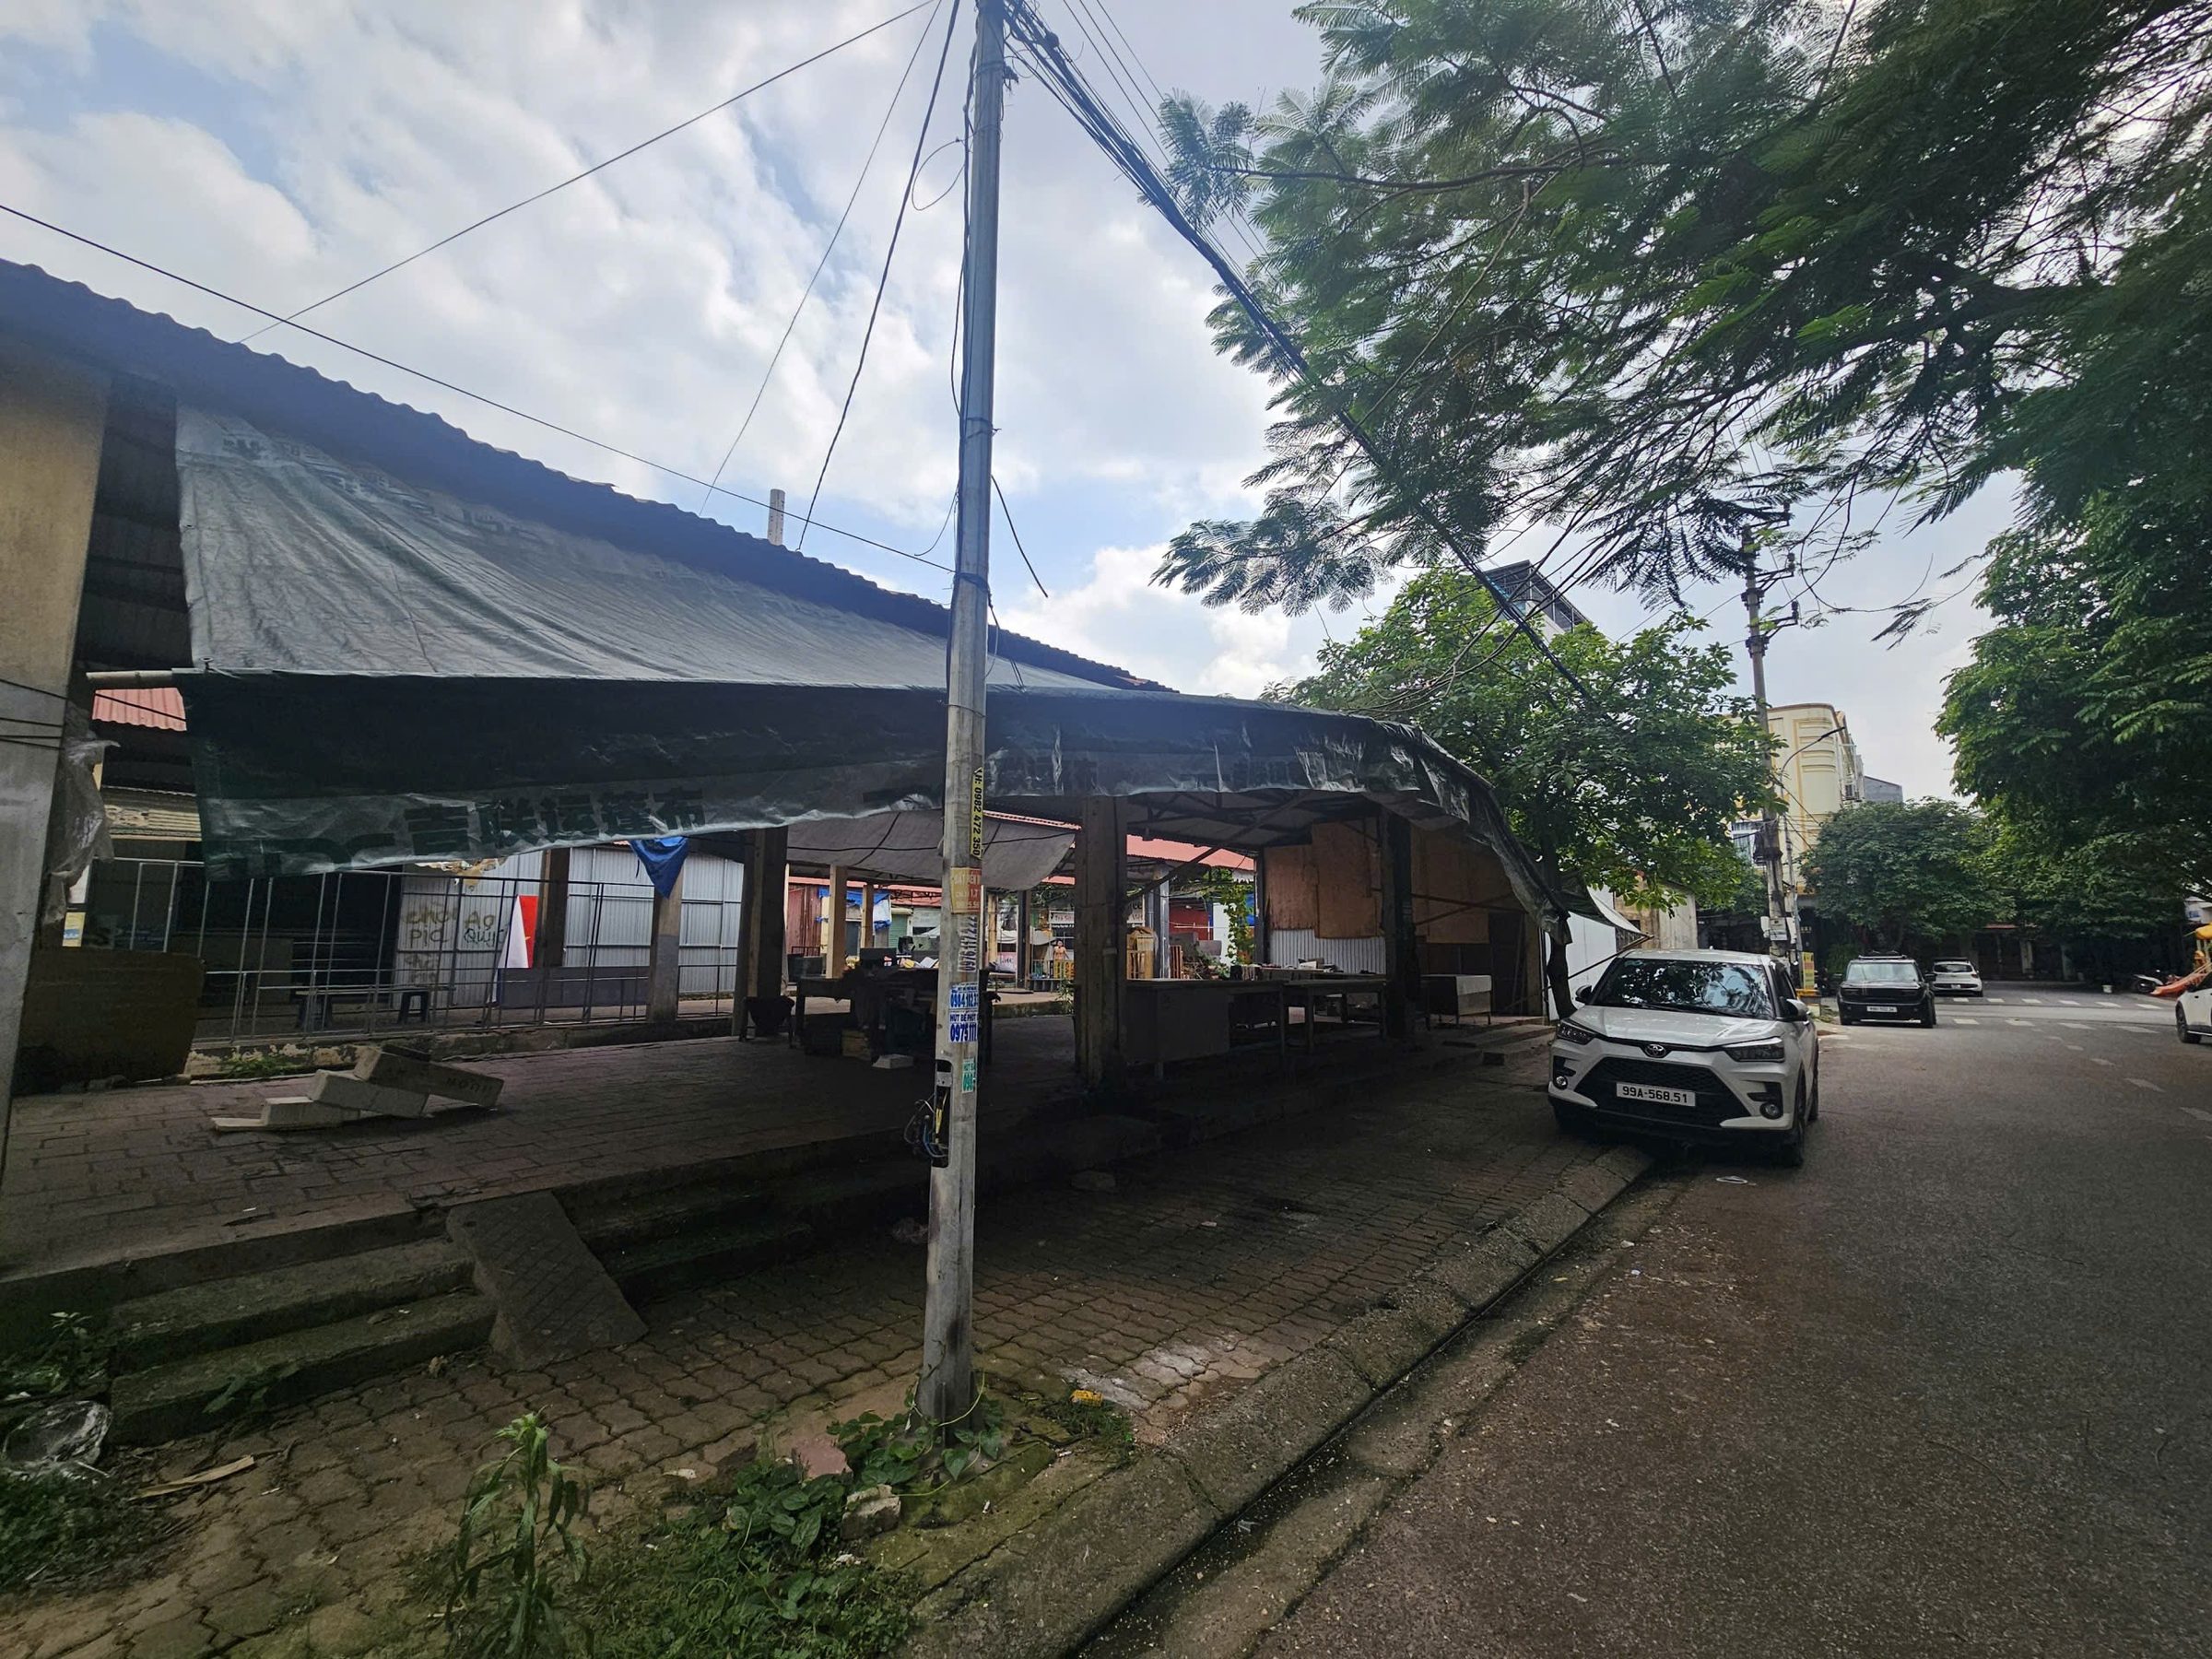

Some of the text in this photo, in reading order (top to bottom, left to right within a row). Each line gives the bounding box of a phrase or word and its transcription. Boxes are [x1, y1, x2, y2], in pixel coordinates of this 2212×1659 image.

[973, 787, 982, 812] 0982
[973, 815, 982, 833] 472
[972, 837, 982, 856] 350
[1622, 1086, 1688, 1103] 99A-568.51
